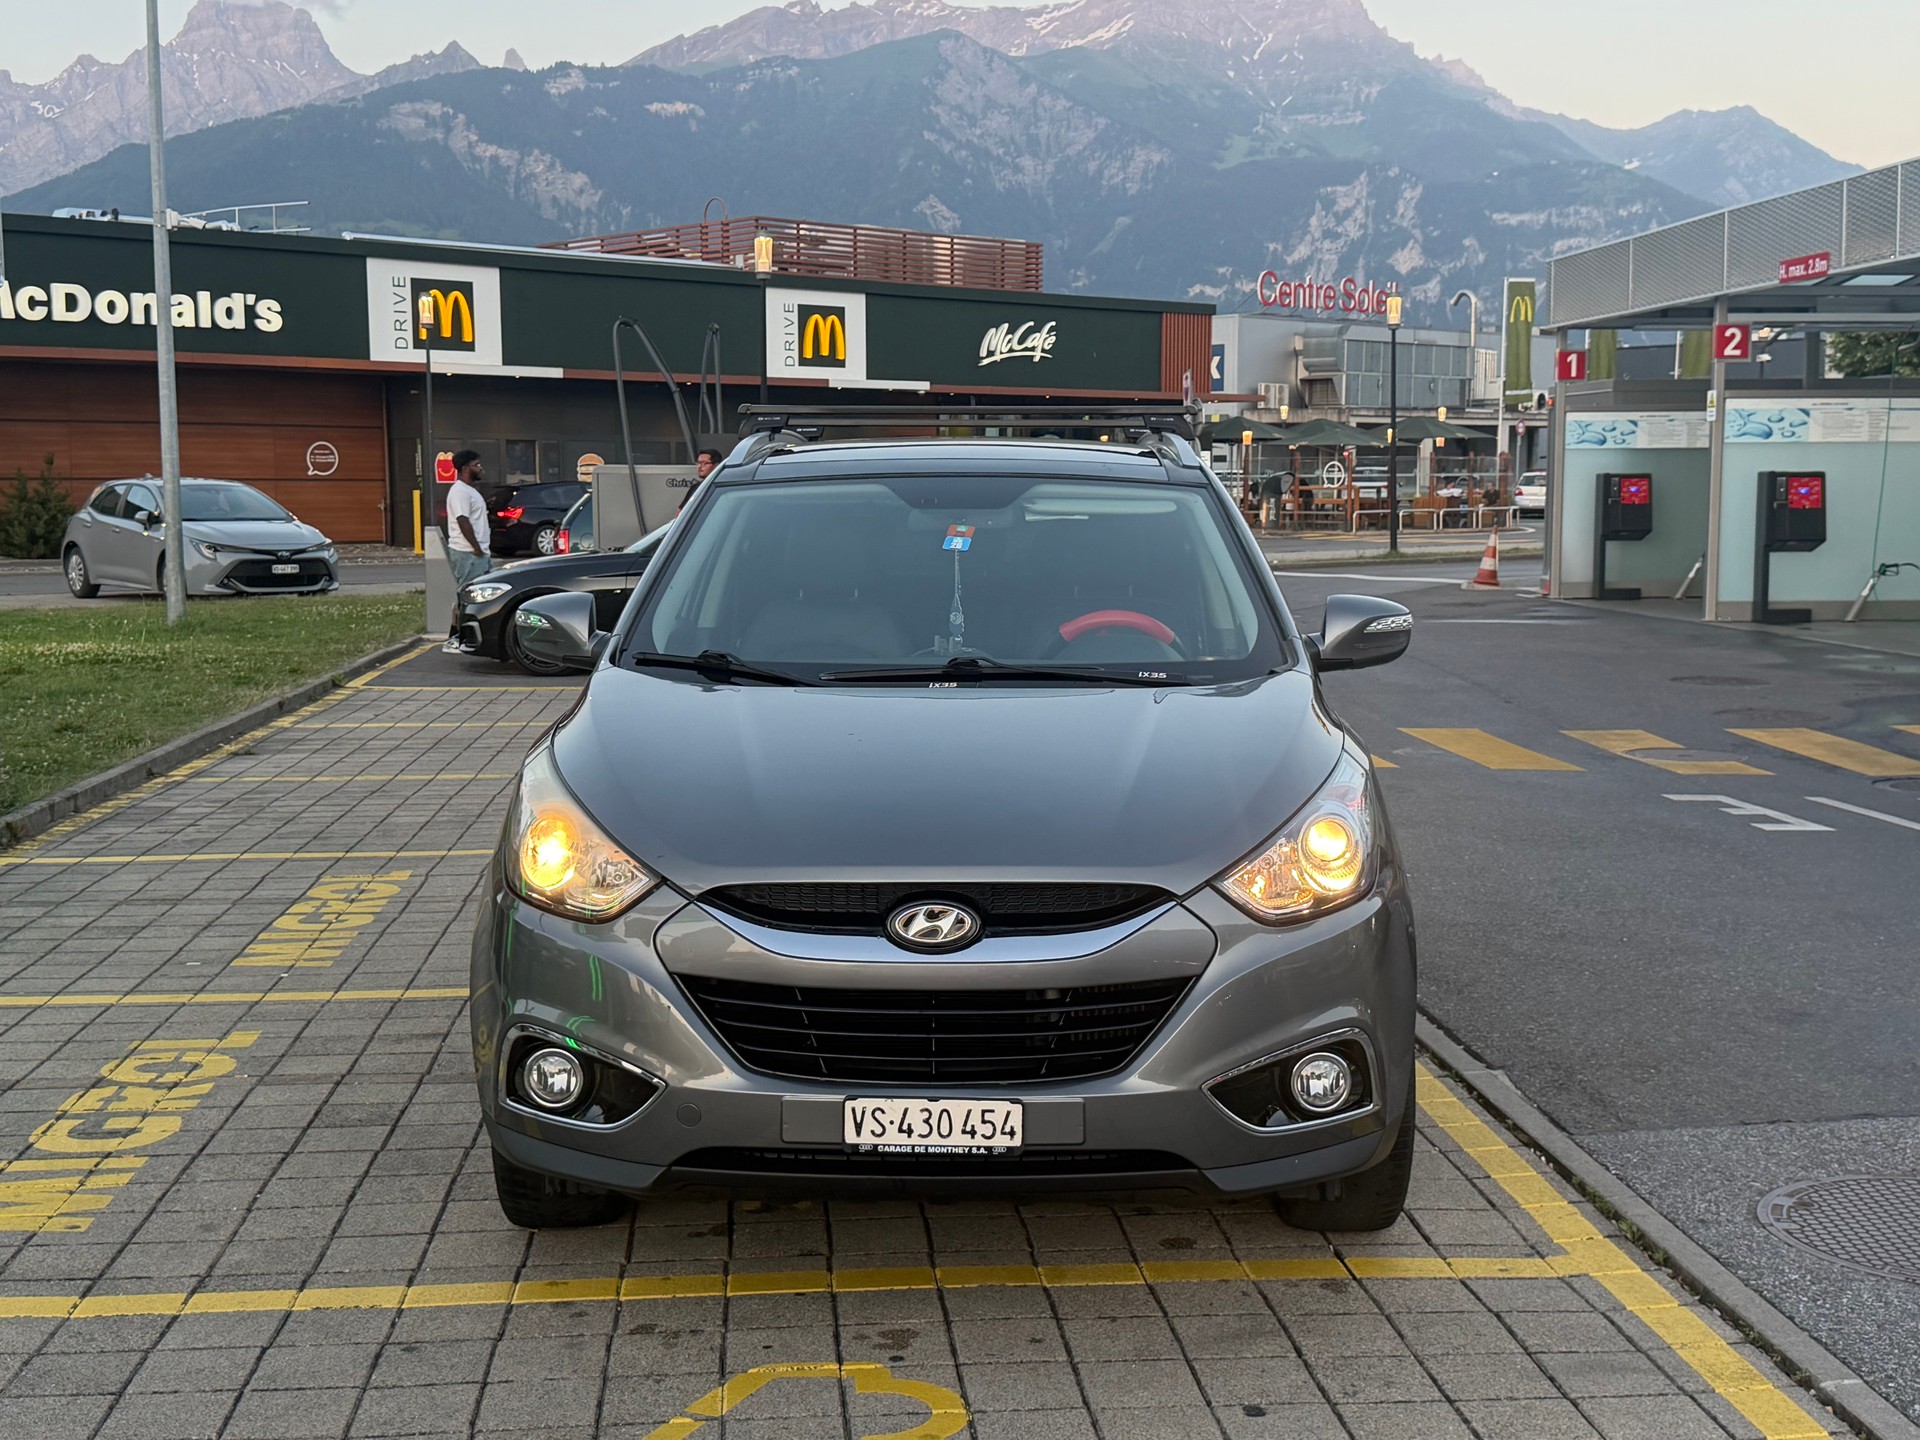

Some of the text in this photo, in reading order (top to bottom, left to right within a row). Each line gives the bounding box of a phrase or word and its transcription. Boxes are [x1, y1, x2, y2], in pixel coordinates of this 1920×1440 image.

[1788, 264, 1807, 278] max.
[1808, 257, 1828, 275] 2.8m
[392, 276, 408, 349] DRIVE
[1257, 269, 1399, 315] Centre Sole
[783, 303, 795, 366] DRIVE
[978, 321, 1057, 363] McCafé
[1723, 327, 1742, 356] 2
[1566, 353, 1578, 378] 1
[230, 870, 413, 967] MIGROL
[877, 1145, 988, 1154] GARAGE DE MONTHEY S.A.
